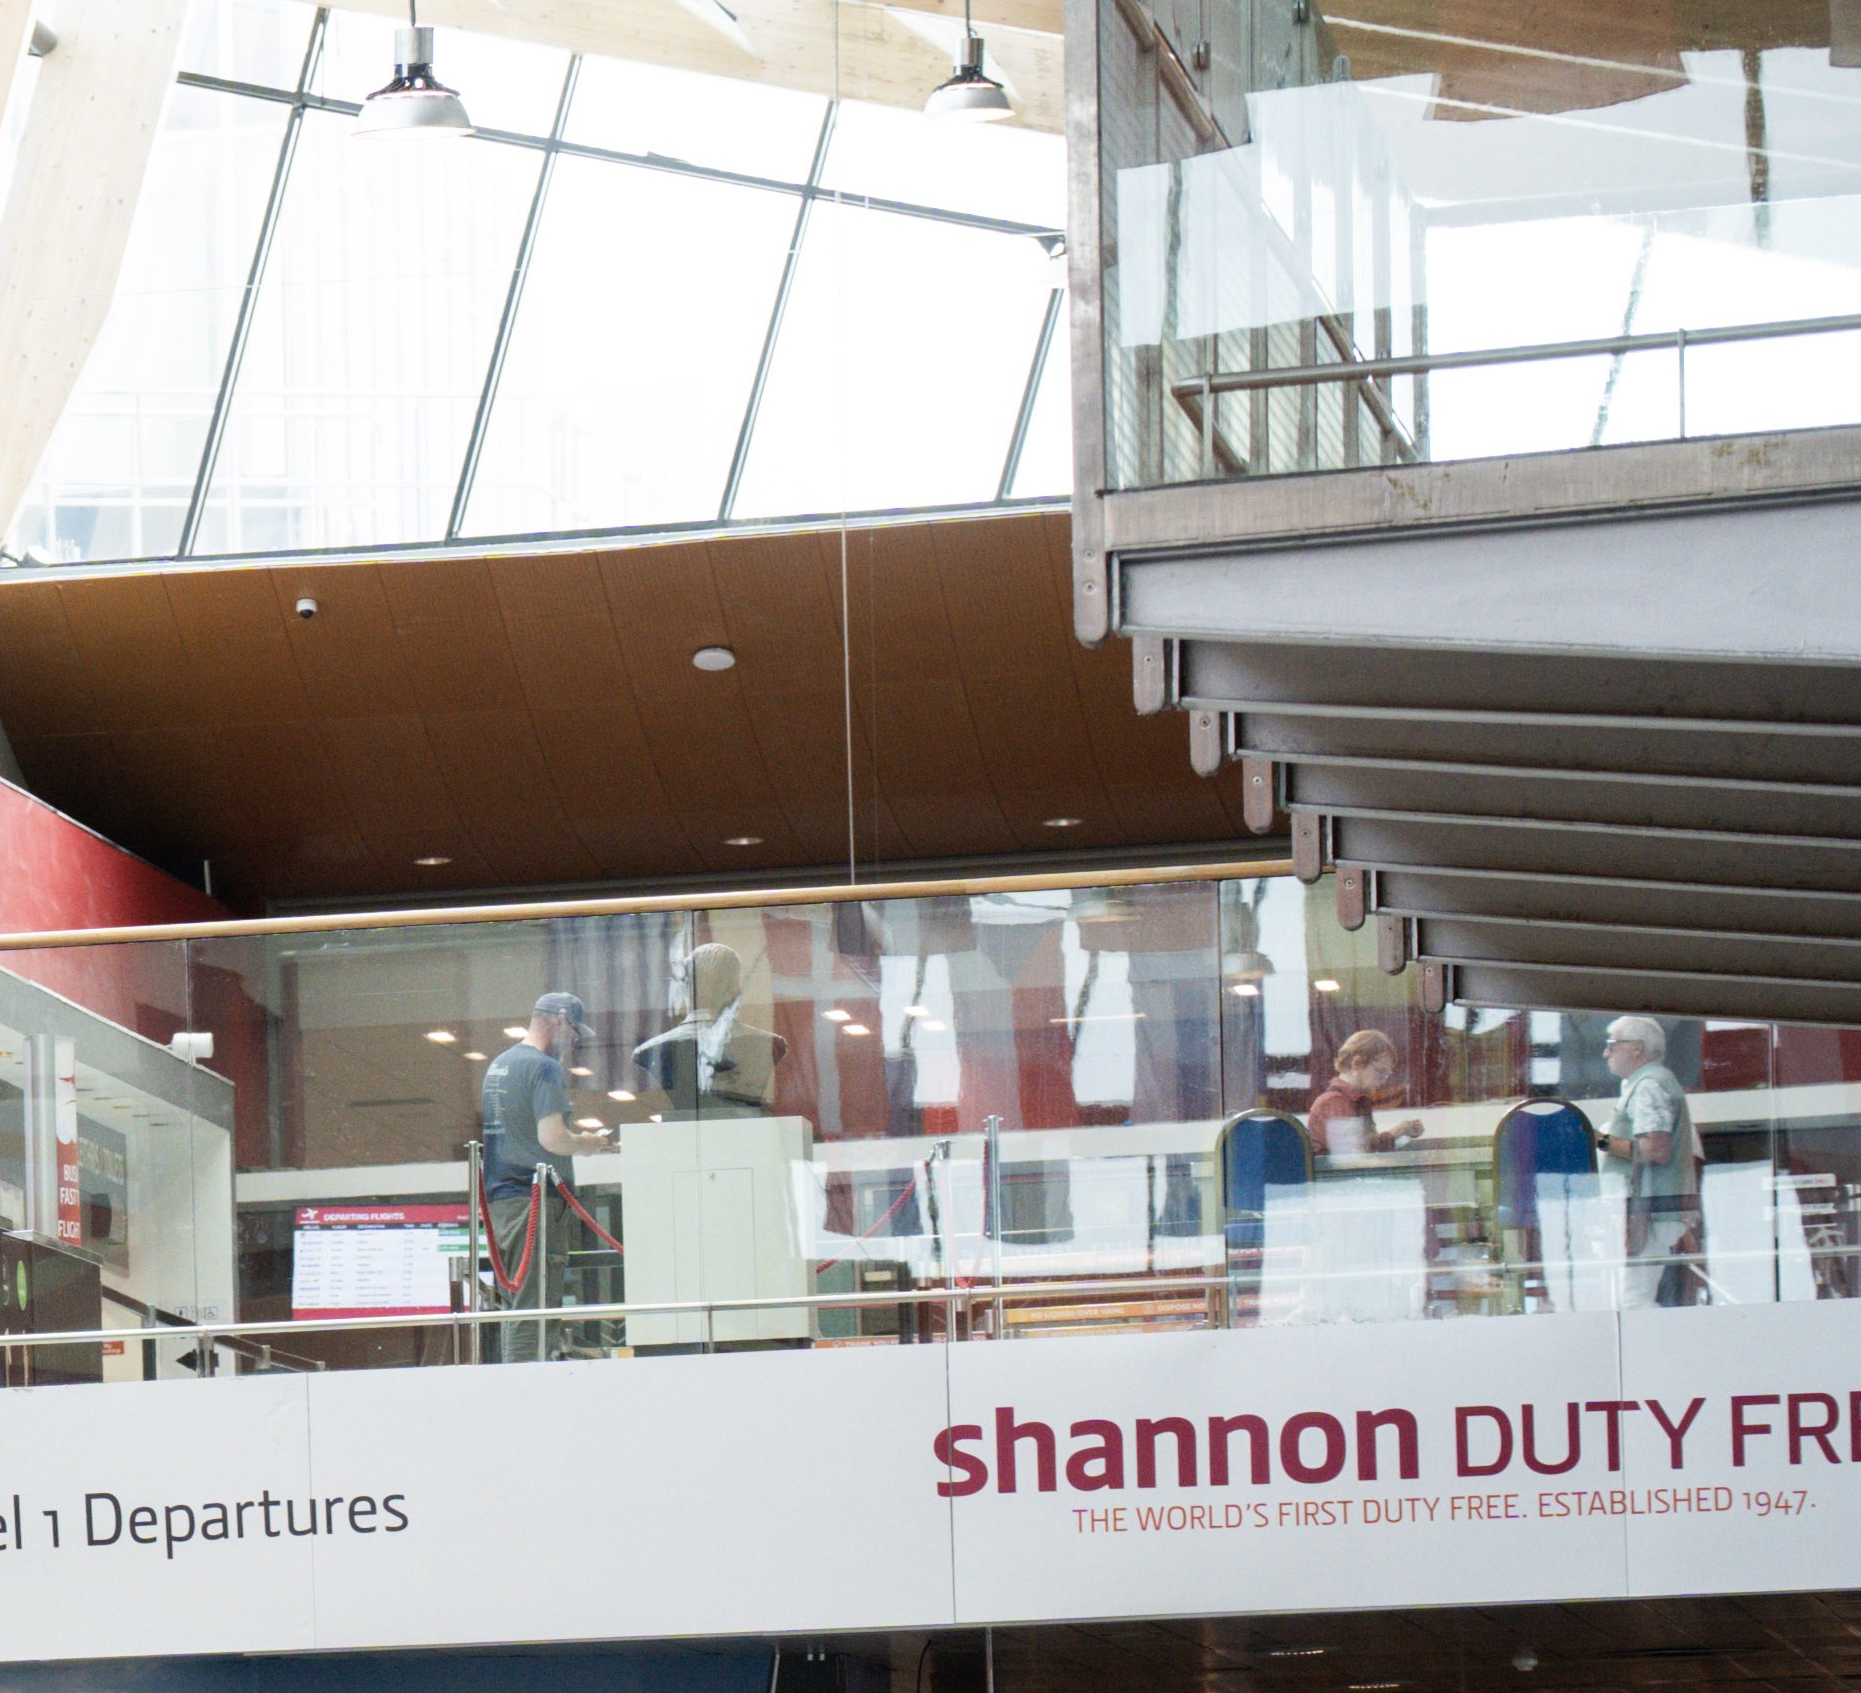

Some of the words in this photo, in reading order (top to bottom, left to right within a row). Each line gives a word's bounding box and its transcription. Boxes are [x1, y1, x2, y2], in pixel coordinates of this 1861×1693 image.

[933, 1406, 1420, 1498] shannon
[1454, 1397, 1707, 1477] DUTY
[1732, 1391, 1861, 1467] FR
[43, 1510, 61, 1549] 1
[84, 1489, 409, 1560] Departures
[1074, 1507, 1128, 1533] THE
[1135, 1501, 1268, 1531] WORLD'S
[1279, 1500, 1350, 1528] FIRST
[1363, 1497, 1440, 1525] DUTY
[1451, 1493, 1528, 1522] FREE.
[1540, 1487, 1732, 1519] ESTABLISHED
[1743, 1489, 1817, 1520] 1947.
